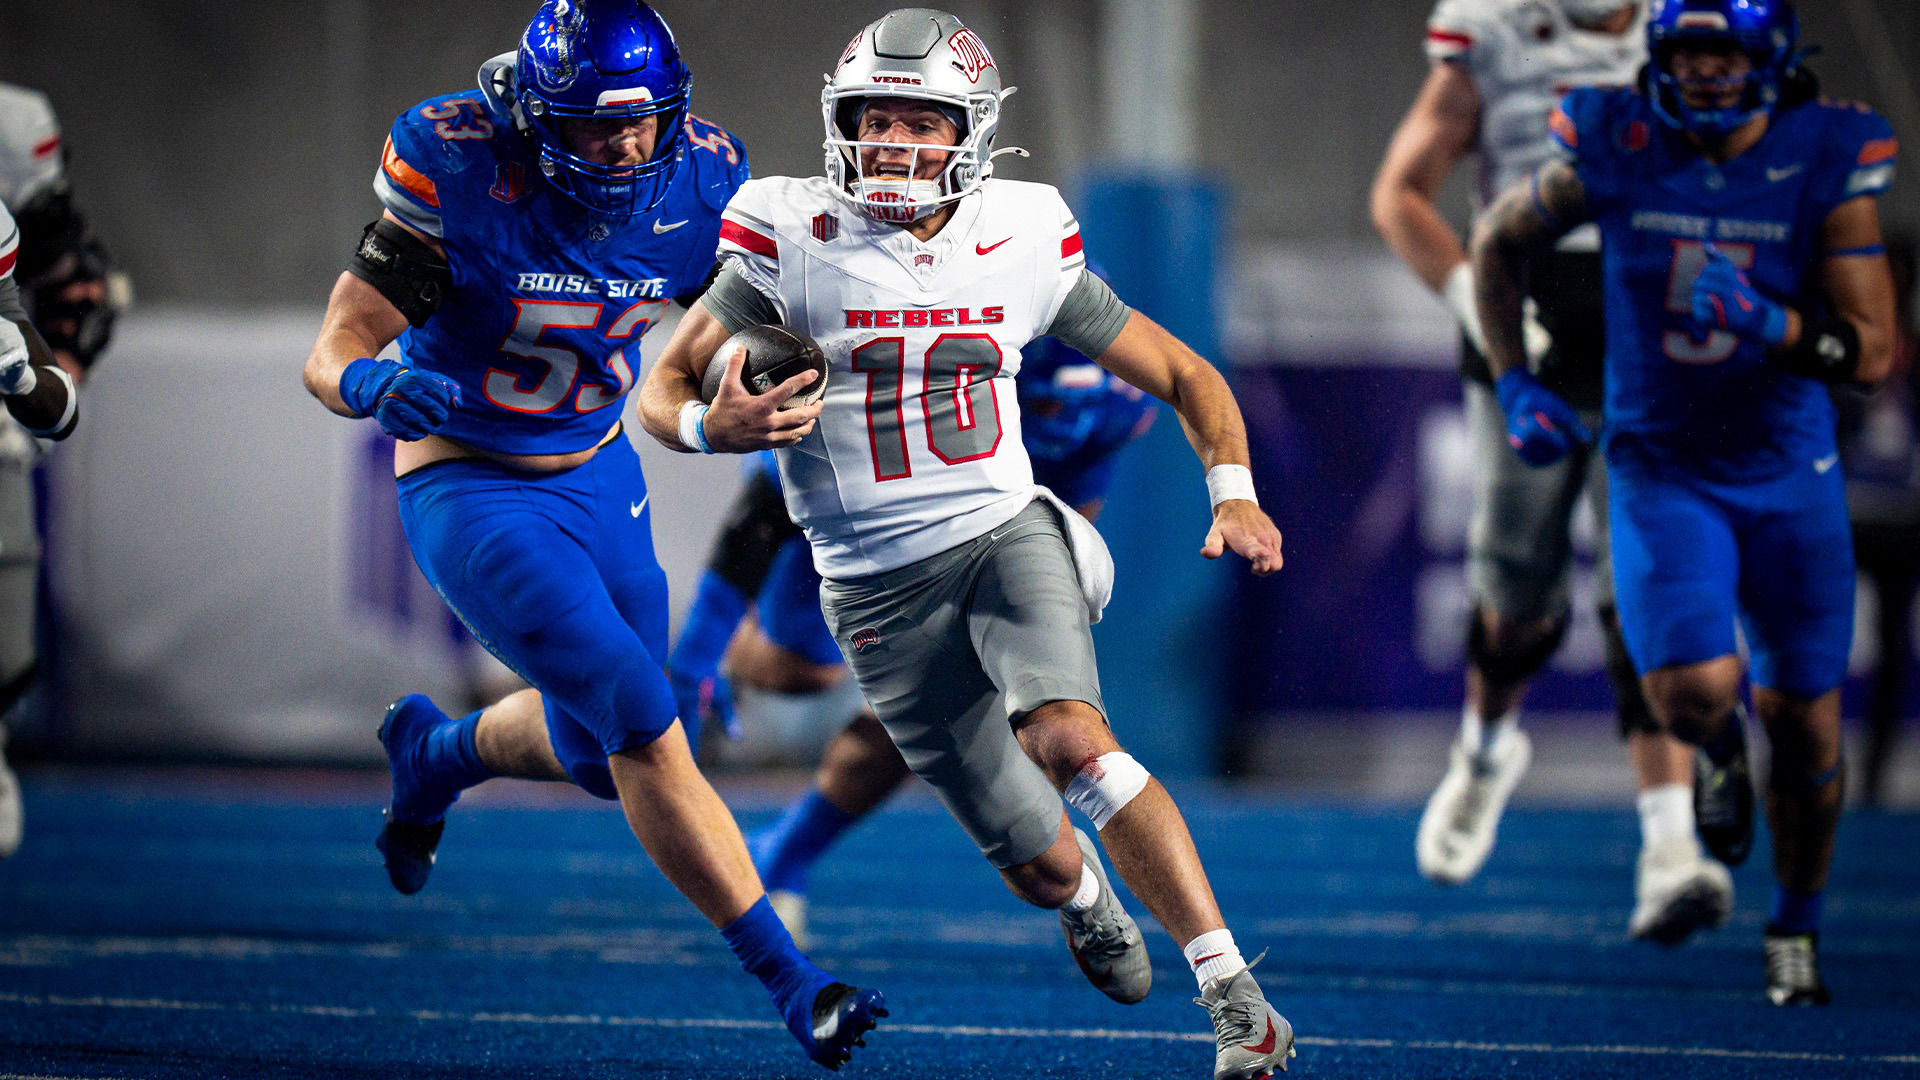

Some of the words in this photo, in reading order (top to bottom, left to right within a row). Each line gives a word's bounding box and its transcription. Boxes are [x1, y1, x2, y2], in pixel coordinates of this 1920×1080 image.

[872, 76, 921, 85] VEGAS
[420, 98, 494, 140] 53
[600, 185, 630, 193] Rddell
[516, 273, 603, 294] BOISE
[606, 278, 668, 298] STATE
[844, 305, 1004, 329] REBELS
[482, 298, 669, 414] 53
[851, 333, 1003, 483] 10
